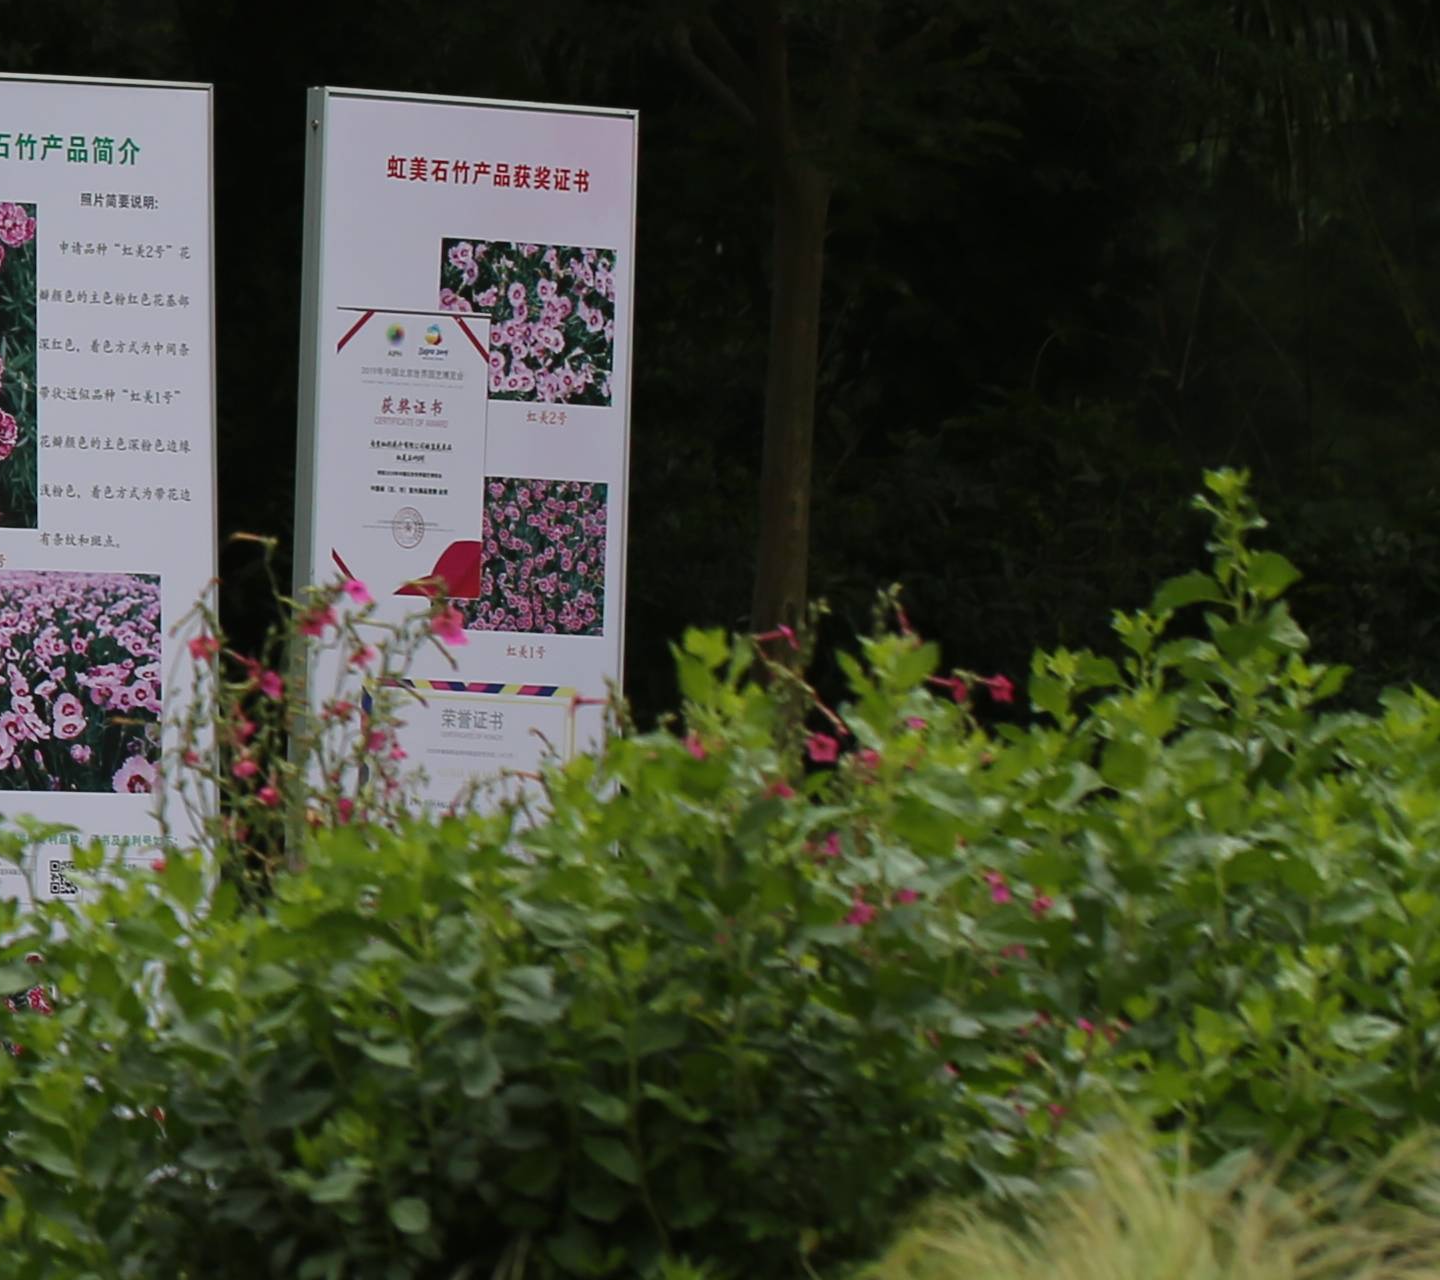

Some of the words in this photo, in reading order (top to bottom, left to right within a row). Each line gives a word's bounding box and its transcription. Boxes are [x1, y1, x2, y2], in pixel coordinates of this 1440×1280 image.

[387, 155, 589, 192] 虹美石竹产品获奖证书
[382, 396, 442, 416] 获奖证书
[526, 410, 567, 425] 虹美2号
[442, 709, 504, 733] 荣誉证书
